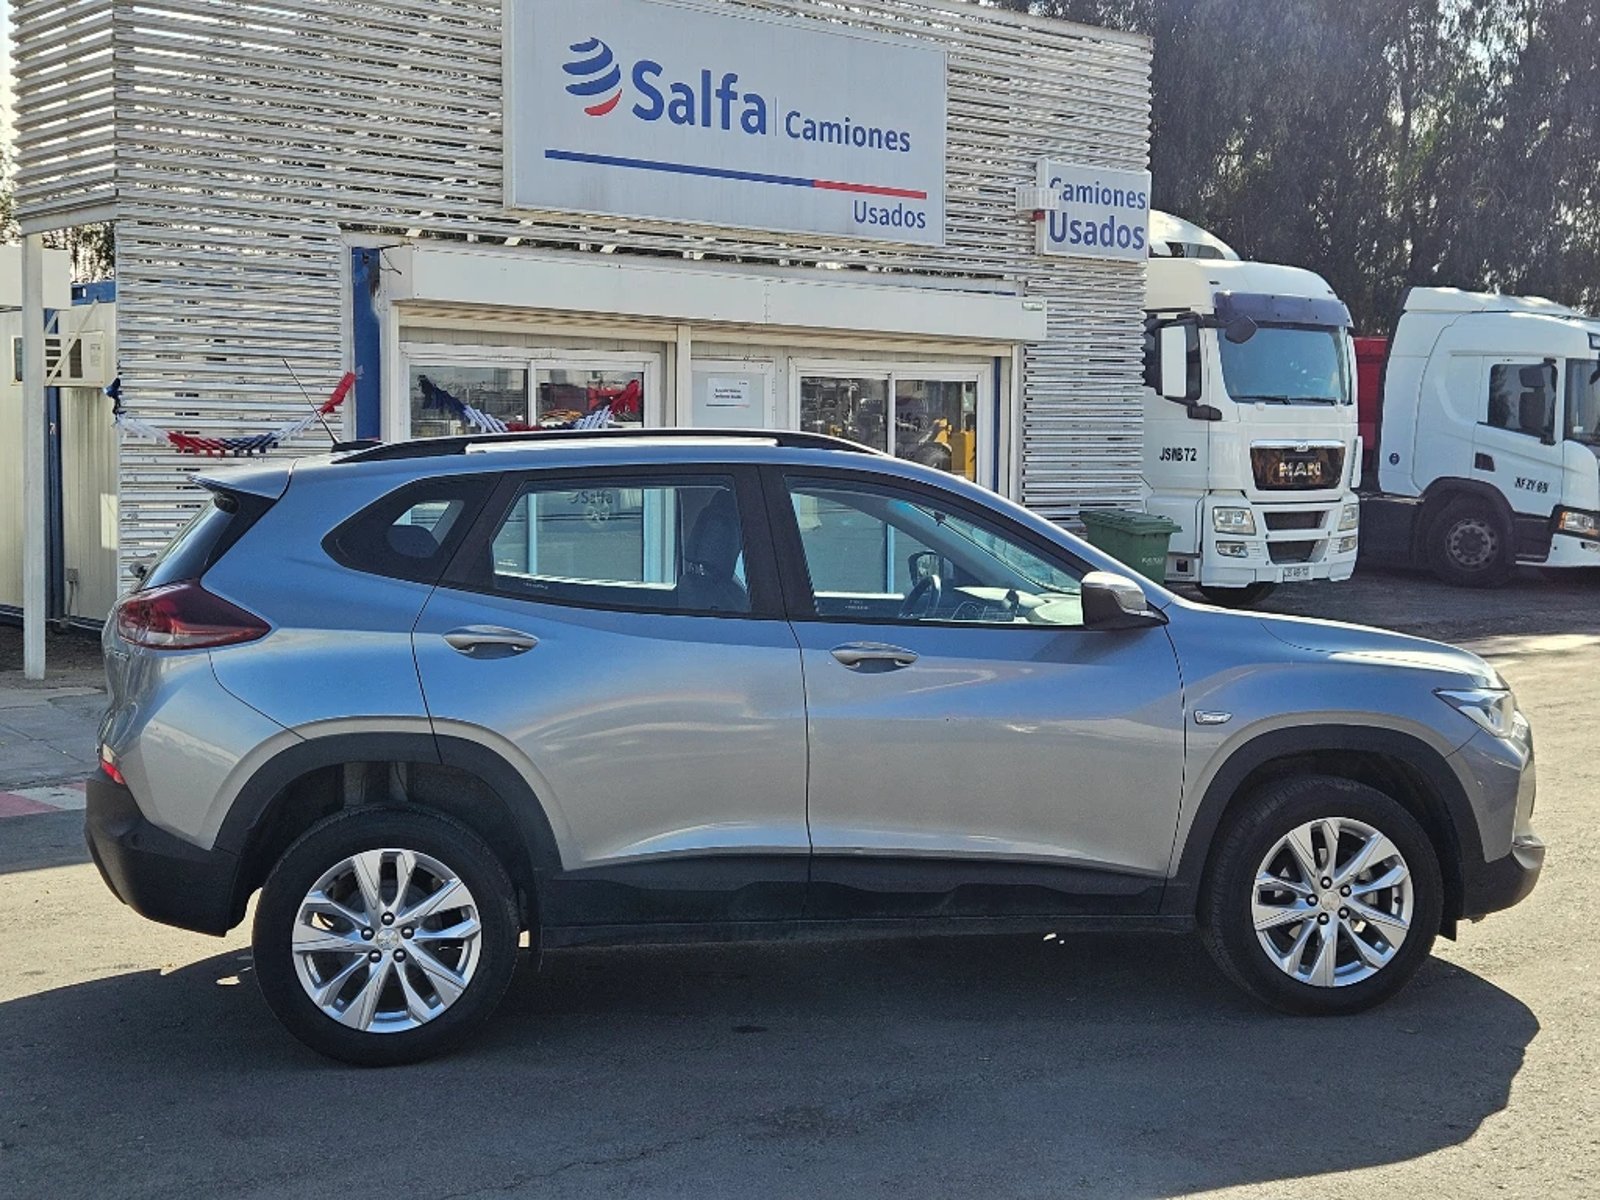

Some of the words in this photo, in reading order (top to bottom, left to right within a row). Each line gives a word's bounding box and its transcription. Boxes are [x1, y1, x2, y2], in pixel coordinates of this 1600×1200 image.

[632, 60, 767, 135] Salfa
[785, 110, 911, 152] Camiones
[854, 200, 926, 229] Usados
[1049, 208, 1145, 250] Usados
